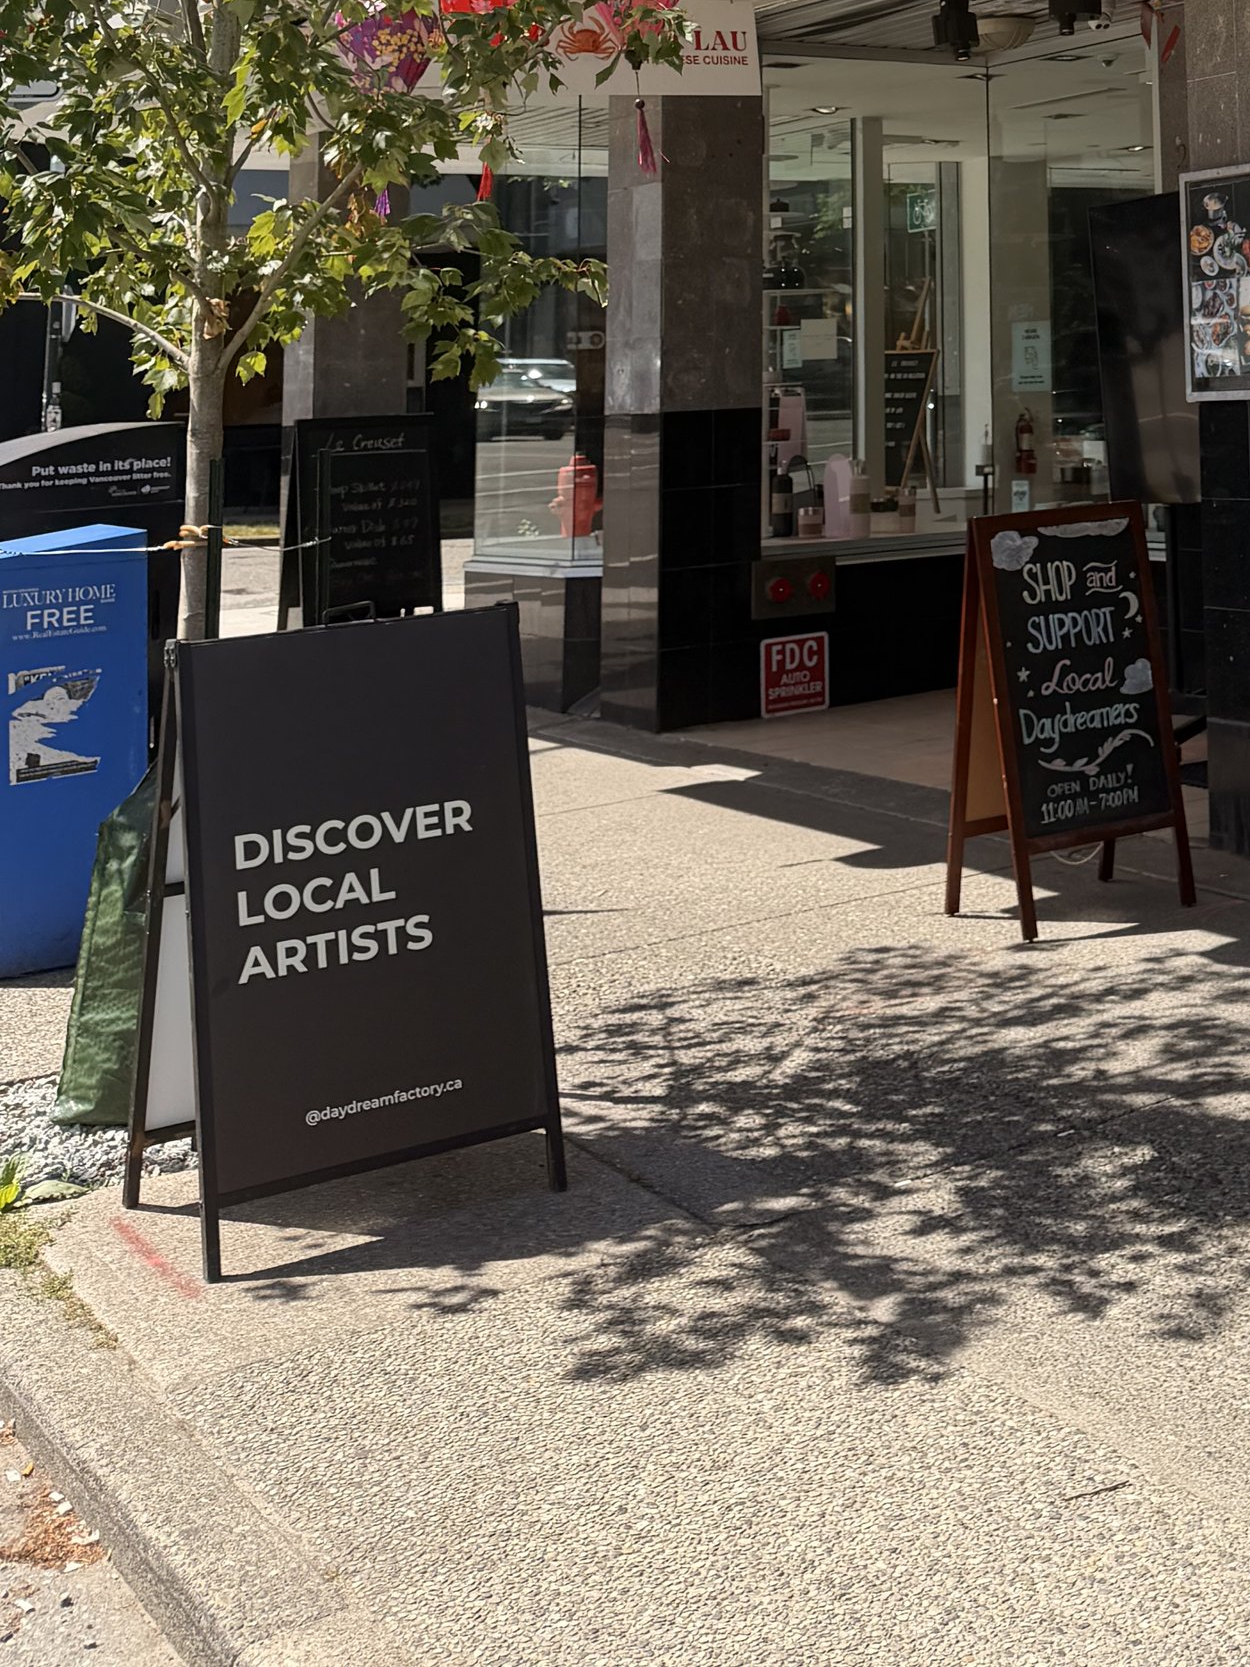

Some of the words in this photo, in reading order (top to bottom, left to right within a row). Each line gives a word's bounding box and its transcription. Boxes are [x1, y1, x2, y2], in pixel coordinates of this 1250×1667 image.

[693, 30, 747, 52] LAU
[703, 55, 749, 66] CUISINE
[352, 432, 405, 450] Creuset
[24, 480, 39, 489] you
[41, 479, 54, 487] for
[55, 477, 87, 487] keeping
[89, 473, 131, 483] Vancouver
[132, 472, 152, 480] litter
[31, 465, 55, 477] Put
[58, 462, 96, 475] waste
[99, 461, 111, 472] in
[114, 459, 130, 471] its
[133, 456, 171, 471] place!
[3, 588, 65, 609] LUXURY
[68, 584, 116, 602] HOME
[1022, 560, 1076, 605] SHOP
[1086, 566, 1117, 588] and
[26, 605, 95, 631] FREE
[1026, 607, 1116, 654] SUPPORT
[771, 639, 818, 672] FDC
[768, 680, 823, 700] SPRINKLER
[781, 670, 810, 685] AUTO
[1041, 657, 1119, 696] Local
[1019, 701, 1140, 754] Daydreamers
[1047, 780, 1081, 798] OPEN
[1089, 764, 1134, 791] DAILY!
[234, 799, 474, 870] DISCOVER
[237, 867, 397, 927] LOCAL
[238, 914, 434, 985] ARTISTS
[305, 1078, 463, 1126] @daydreamfactory.ca
